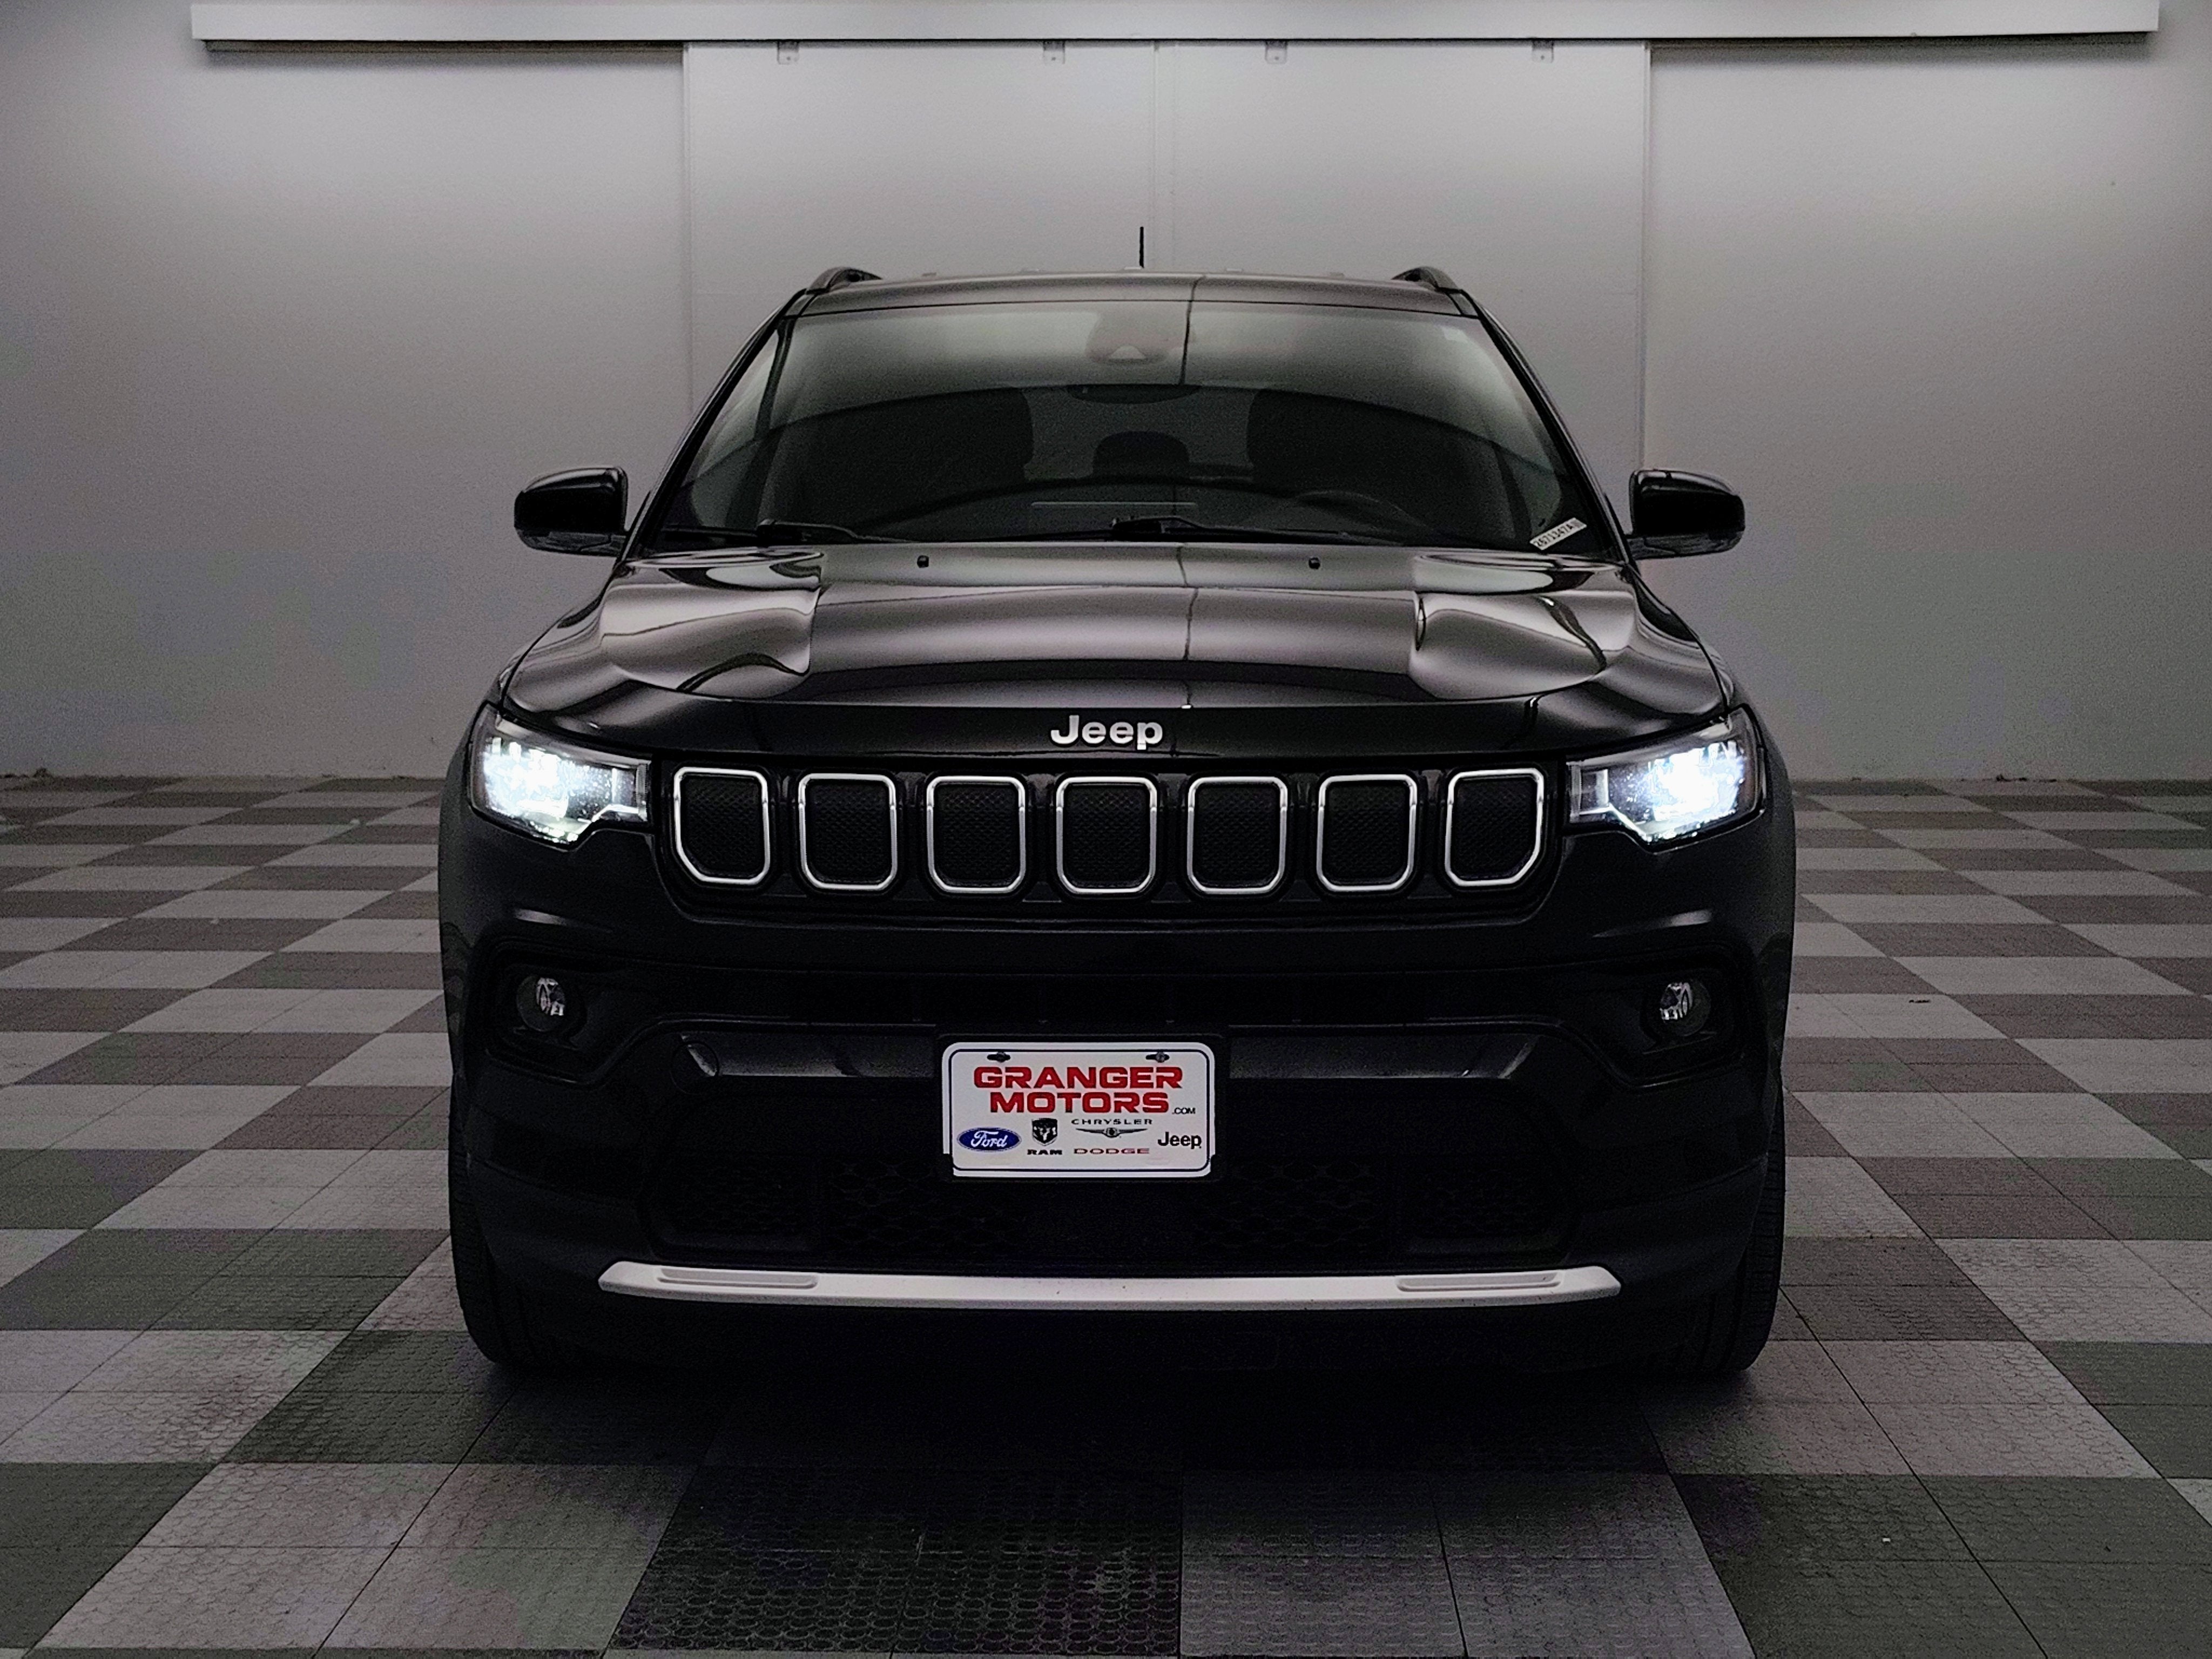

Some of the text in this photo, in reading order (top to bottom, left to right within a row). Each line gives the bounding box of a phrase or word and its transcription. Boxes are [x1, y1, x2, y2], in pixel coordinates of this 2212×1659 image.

[1050, 714, 1163, 750] Jeep
[973, 1066, 1183, 1089] GRANGER
[989, 1091, 1169, 1114] MOTORS
[970, 1130, 1008, 1148] Ford
[1157, 1131, 1202, 1150] Jeep
